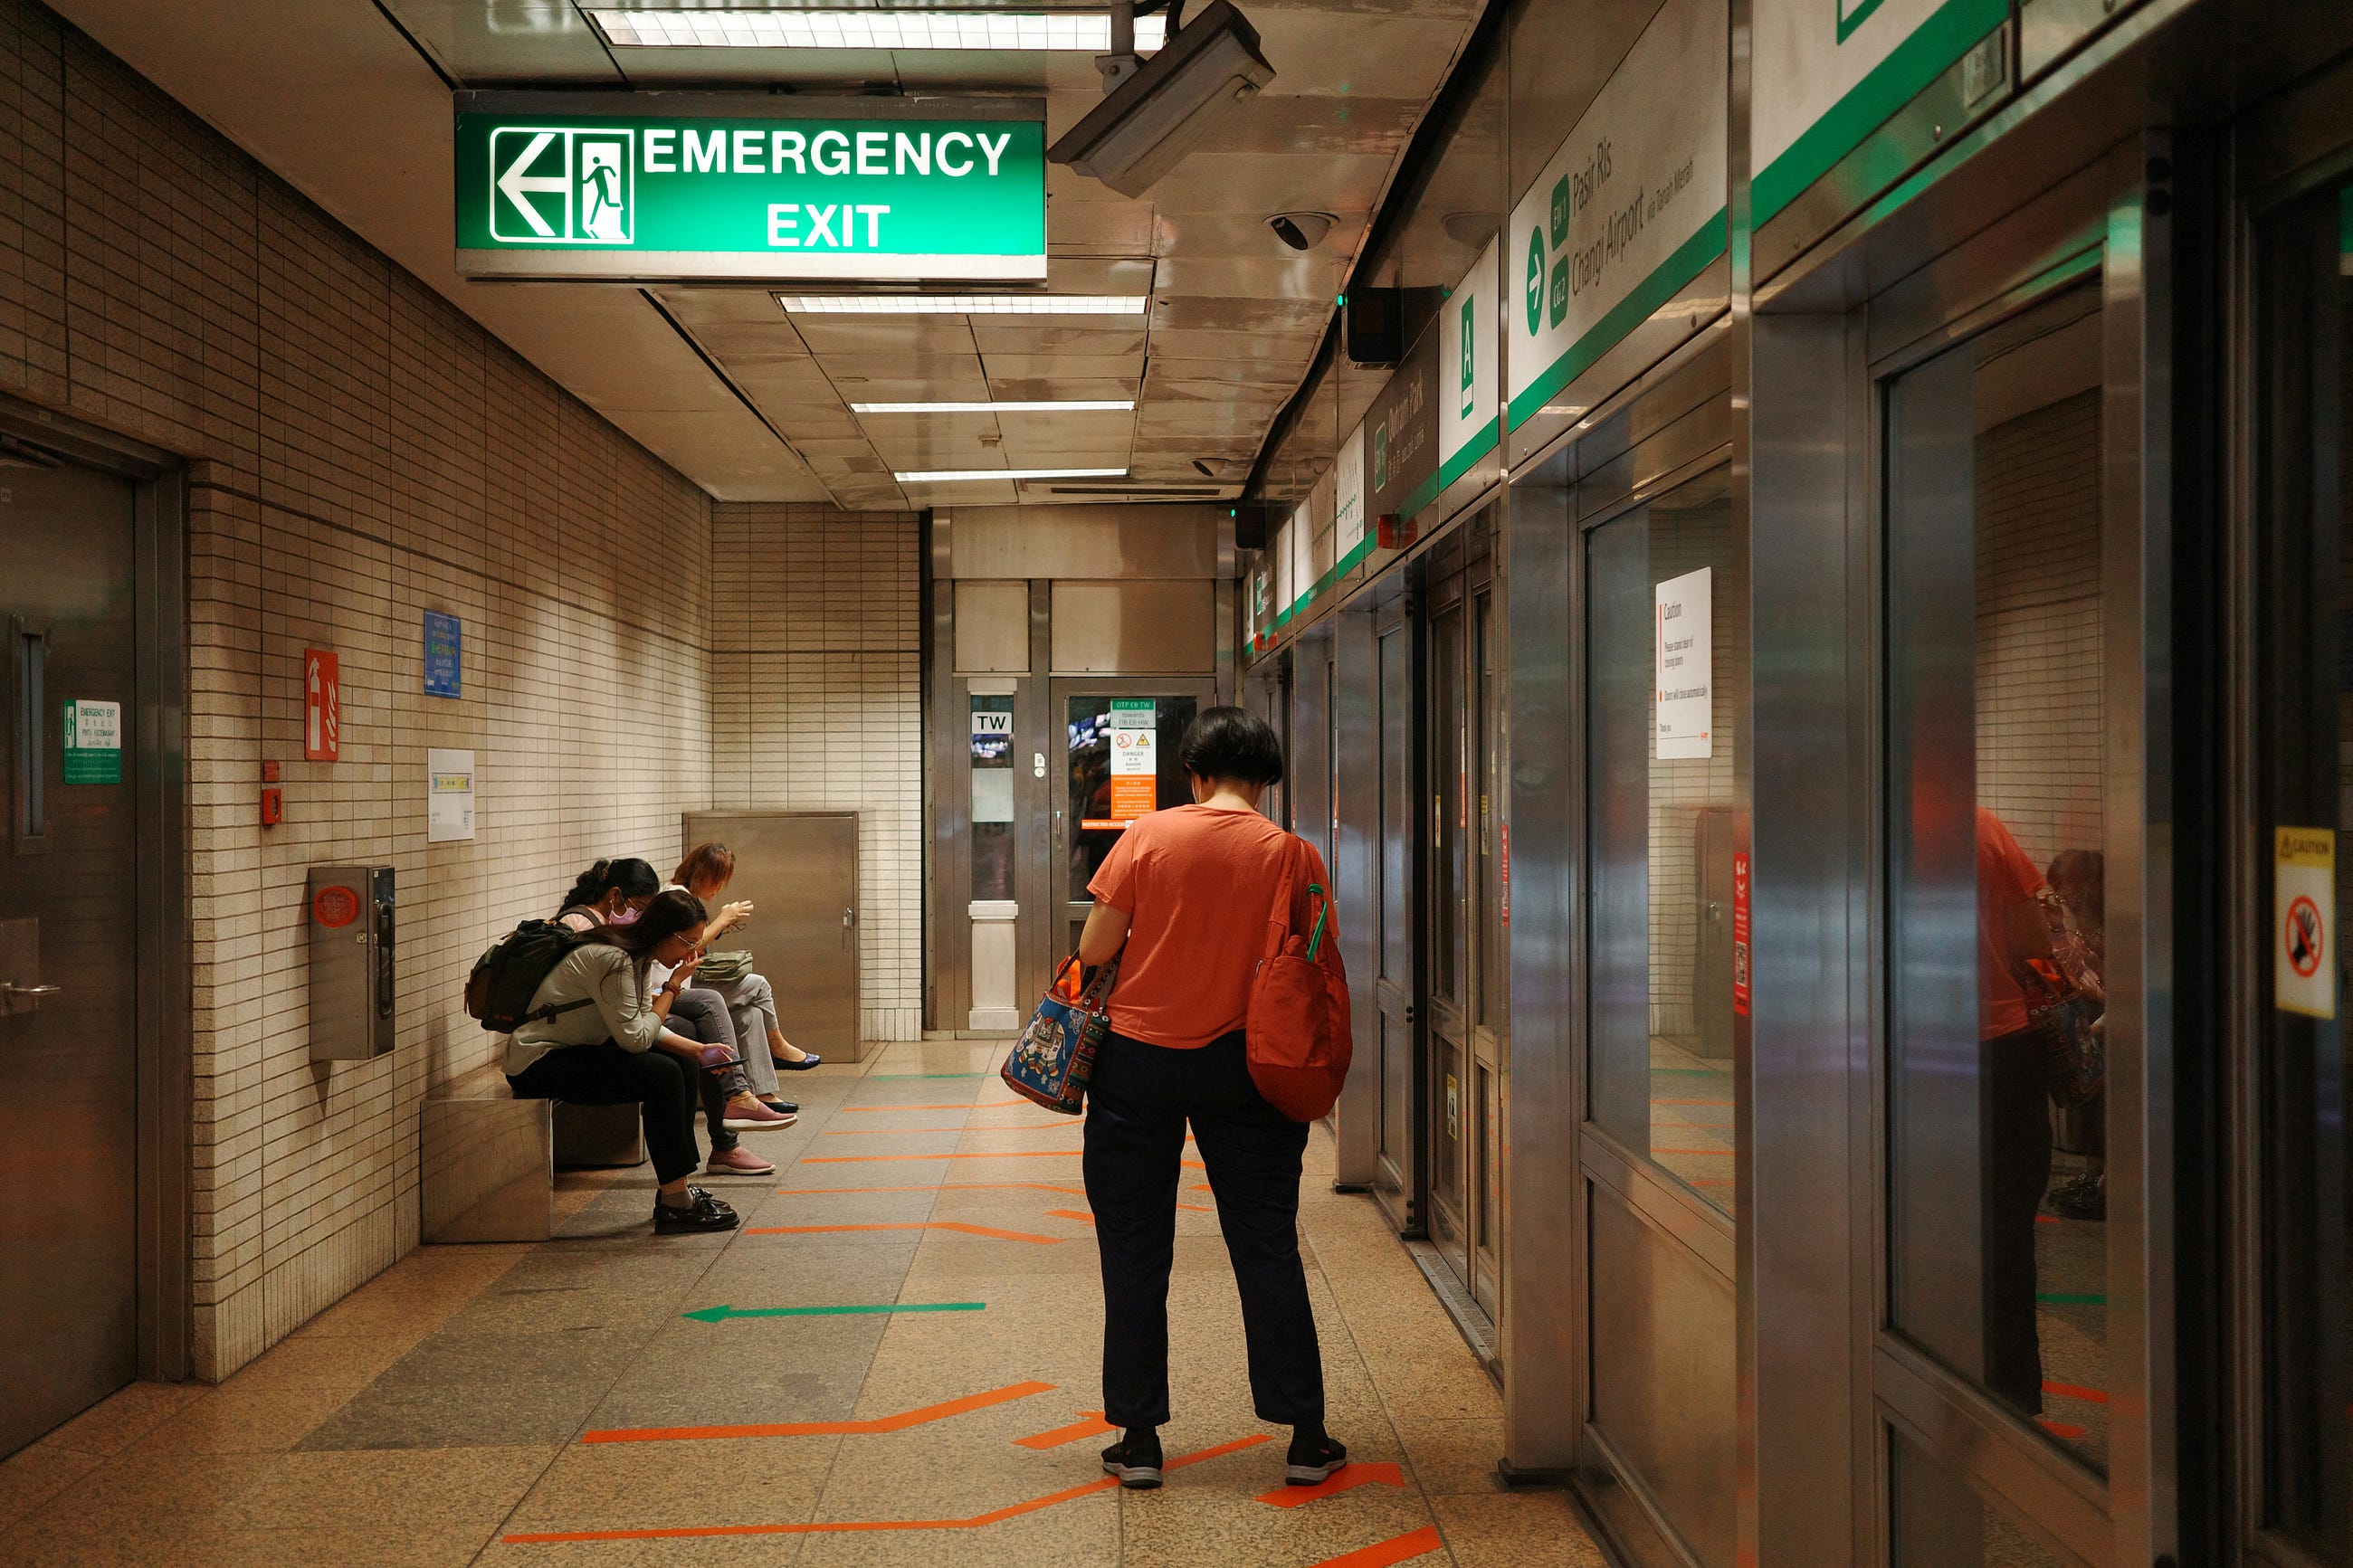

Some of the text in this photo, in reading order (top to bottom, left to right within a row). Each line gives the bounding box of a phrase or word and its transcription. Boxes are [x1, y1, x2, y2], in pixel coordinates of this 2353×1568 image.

[643, 128, 1012, 176] EMERGENCY
[1573, 155, 1596, 218] Pasir
[1597, 135, 1612, 188] Ris
[767, 204, 891, 248] EXIT
[1572, 223, 1605, 297] Changi
[1605, 185, 1644, 265] Airport
[1647, 197, 1655, 223] via
[1656, 177, 1673, 212] Tanah
[1673, 155, 1694, 196] Merah
[1463, 319, 1472, 379] A
[1388, 396, 1409, 442] Outram
[1409, 368, 1424, 421] Park
[1663, 601, 1681, 620] Caution
[80, 708, 116, 717] EMERGENCY EXIT
[976, 716, 1006, 730] TW
[2291, 839, 2330, 856] CAUTION
